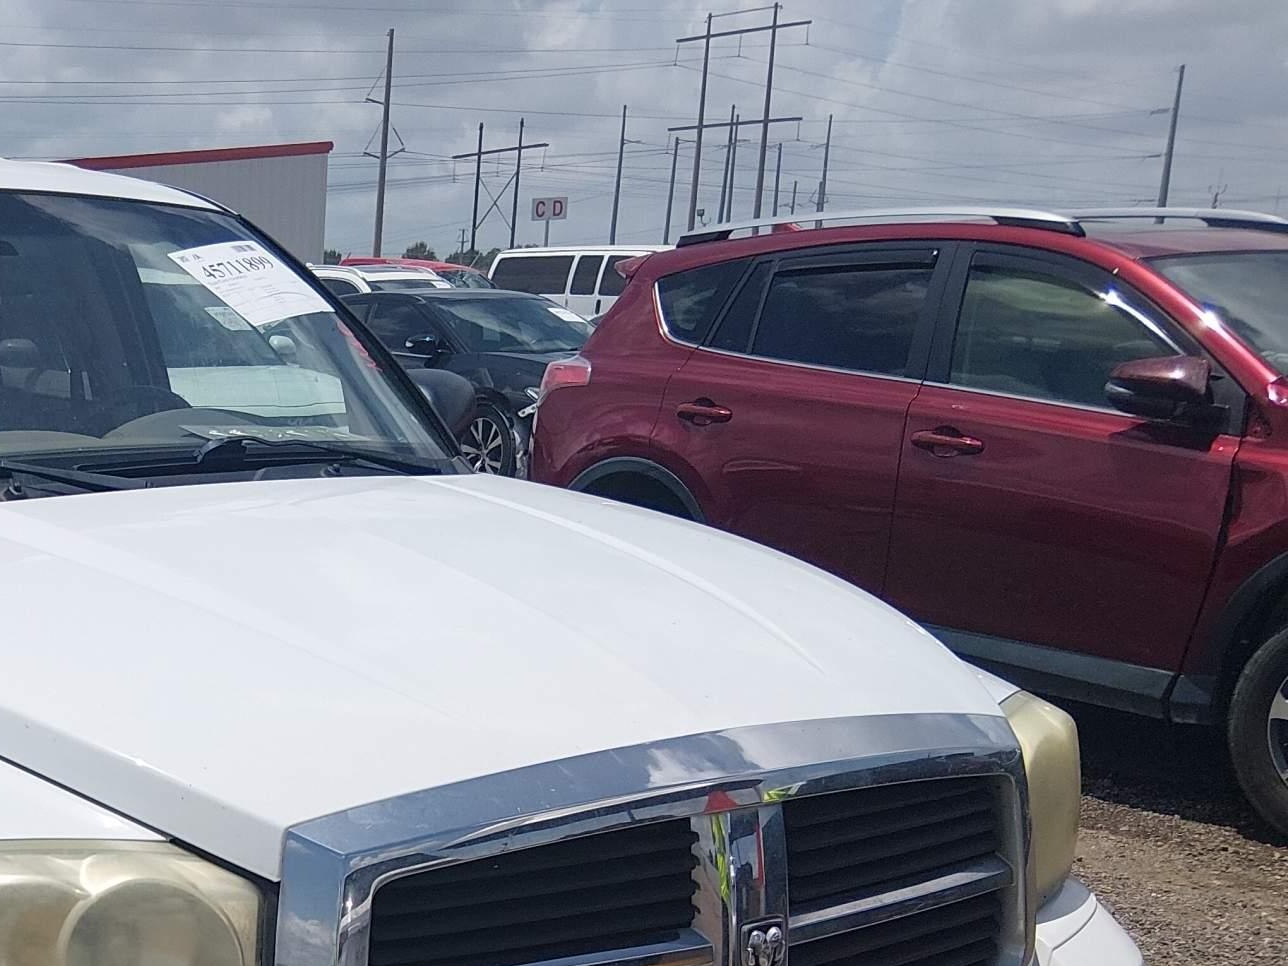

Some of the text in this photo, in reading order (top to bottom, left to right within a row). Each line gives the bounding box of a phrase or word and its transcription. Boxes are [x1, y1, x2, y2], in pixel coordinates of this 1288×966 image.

[536, 200, 563, 218] C D
[202, 256, 274, 279] 45711899
